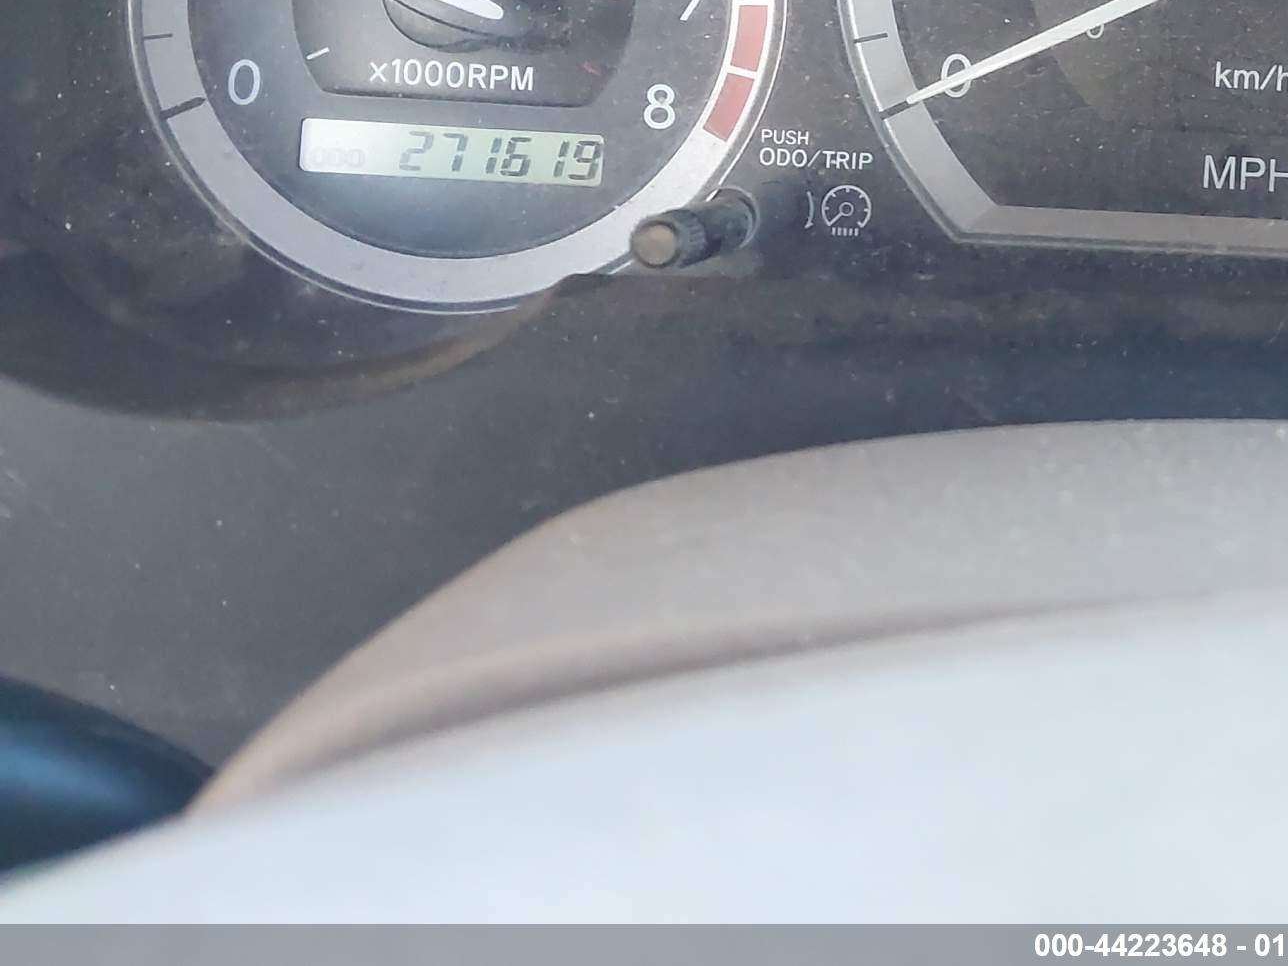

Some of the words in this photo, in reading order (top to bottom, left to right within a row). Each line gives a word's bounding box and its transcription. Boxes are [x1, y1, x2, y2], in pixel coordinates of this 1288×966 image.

[229, 59, 260, 105] 0
[644, 84, 675, 129] 8
[400, 131, 599, 181] 271619
[759, 147, 873, 170] ODO/TRIP
[760, 129, 809, 145] PUSH
